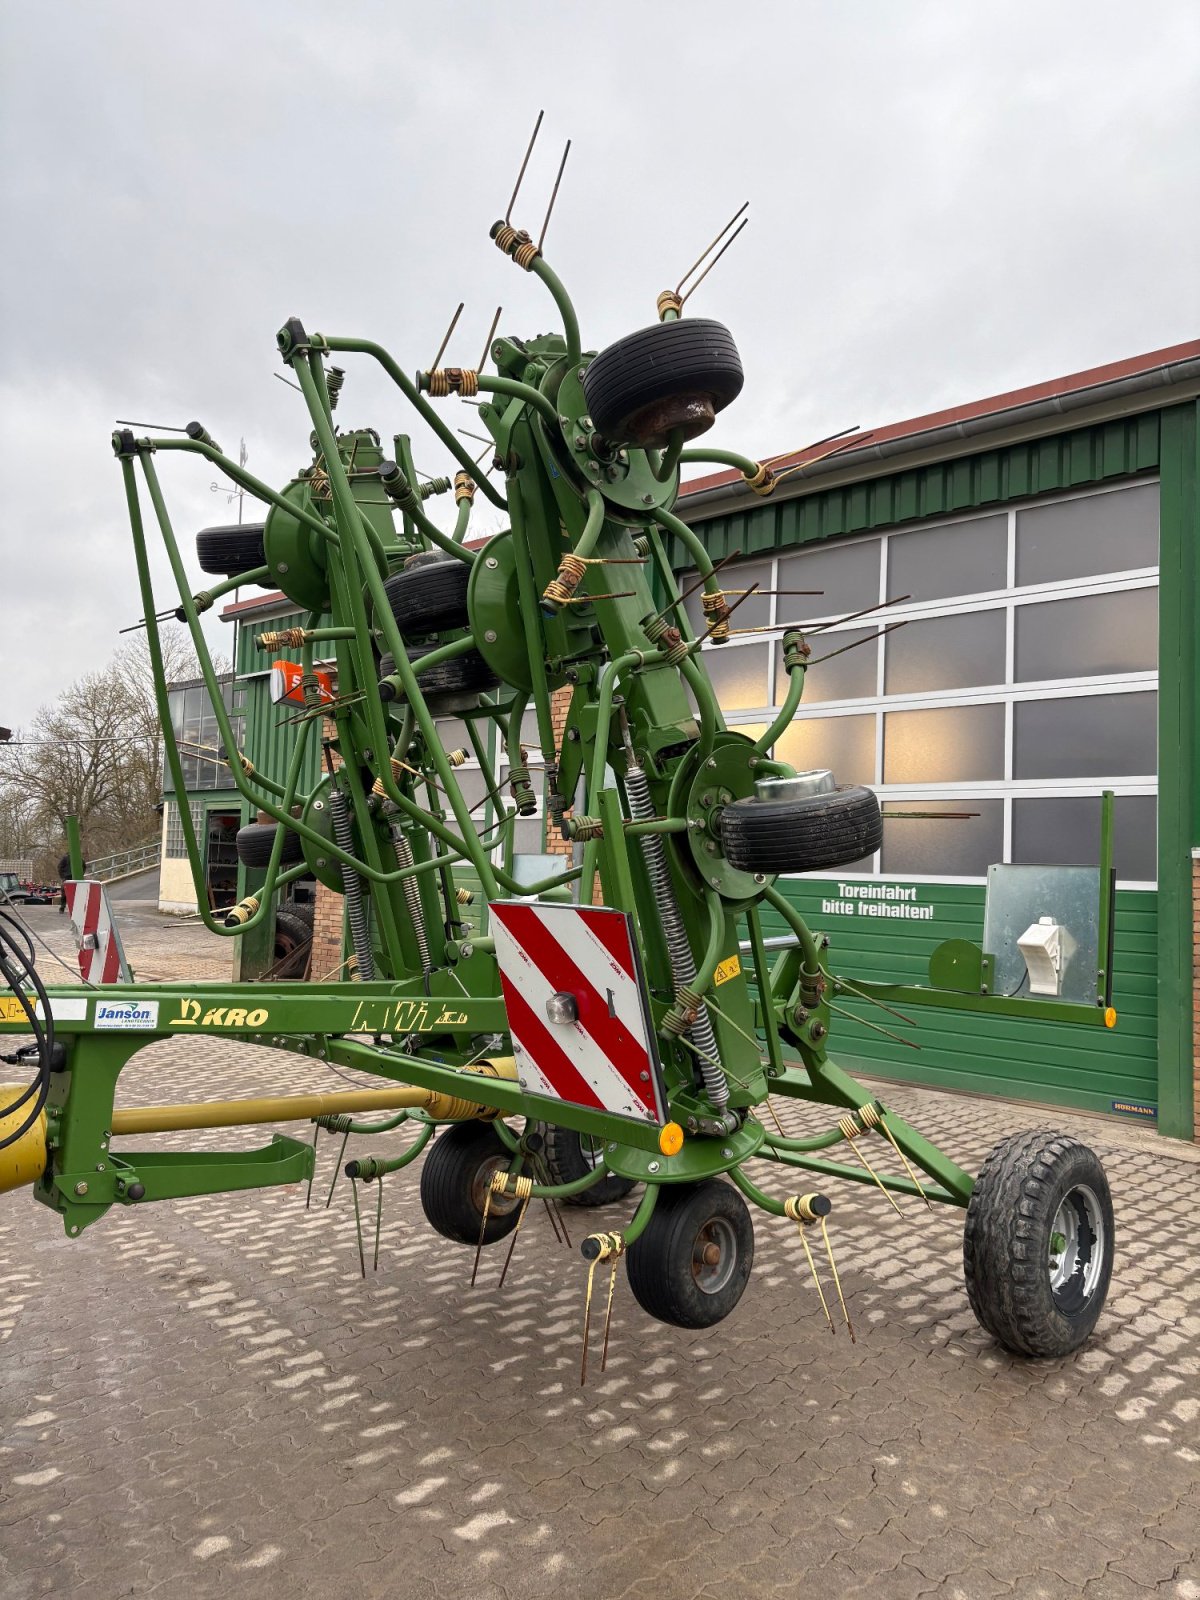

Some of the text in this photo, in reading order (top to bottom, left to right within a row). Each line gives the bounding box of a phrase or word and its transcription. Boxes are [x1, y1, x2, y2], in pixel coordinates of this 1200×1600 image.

[838, 883, 917, 901] Toreinfahrt
[822, 899, 934, 920] bitte freihalten!
[98, 1007, 150, 1019] Janson
